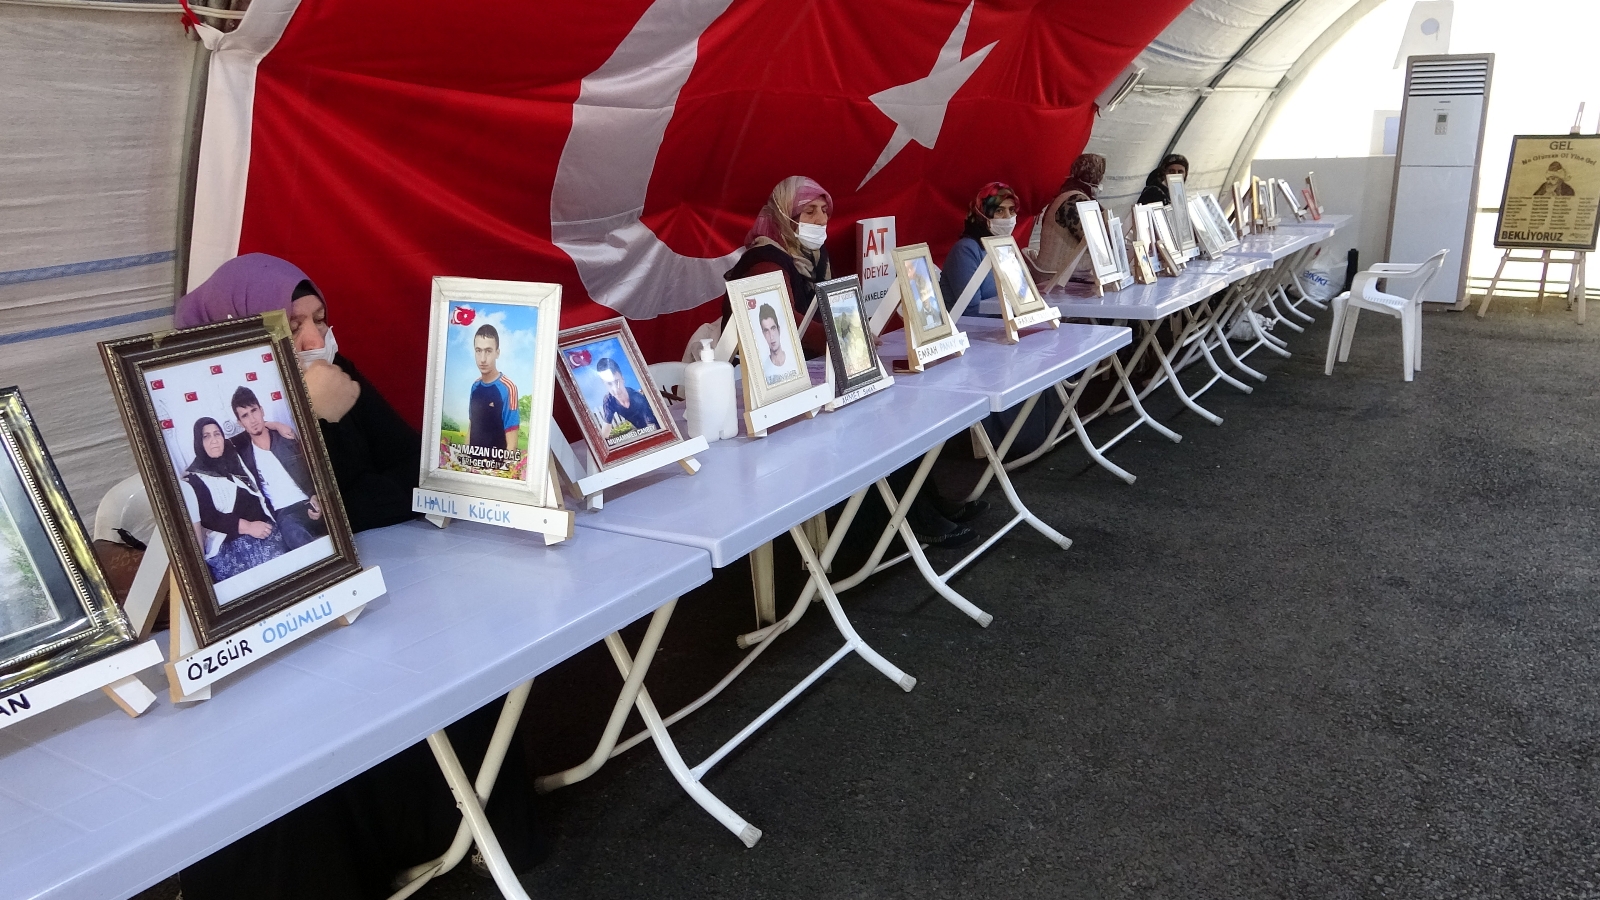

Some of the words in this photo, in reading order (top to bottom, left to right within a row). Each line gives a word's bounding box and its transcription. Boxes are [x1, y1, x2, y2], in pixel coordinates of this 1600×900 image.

[1549, 140, 1574, 151] GEL
[864, 227, 889, 258] AT
[1501, 229, 1564, 242] BEKLİYORUZ
[451, 443, 490, 458] RAMAZAN
[469, 502, 511, 524] KÜÇÜK
[187, 638, 253, 681] ÖZGÜR
[258, 594, 333, 645] ÖDÜMLÜ
